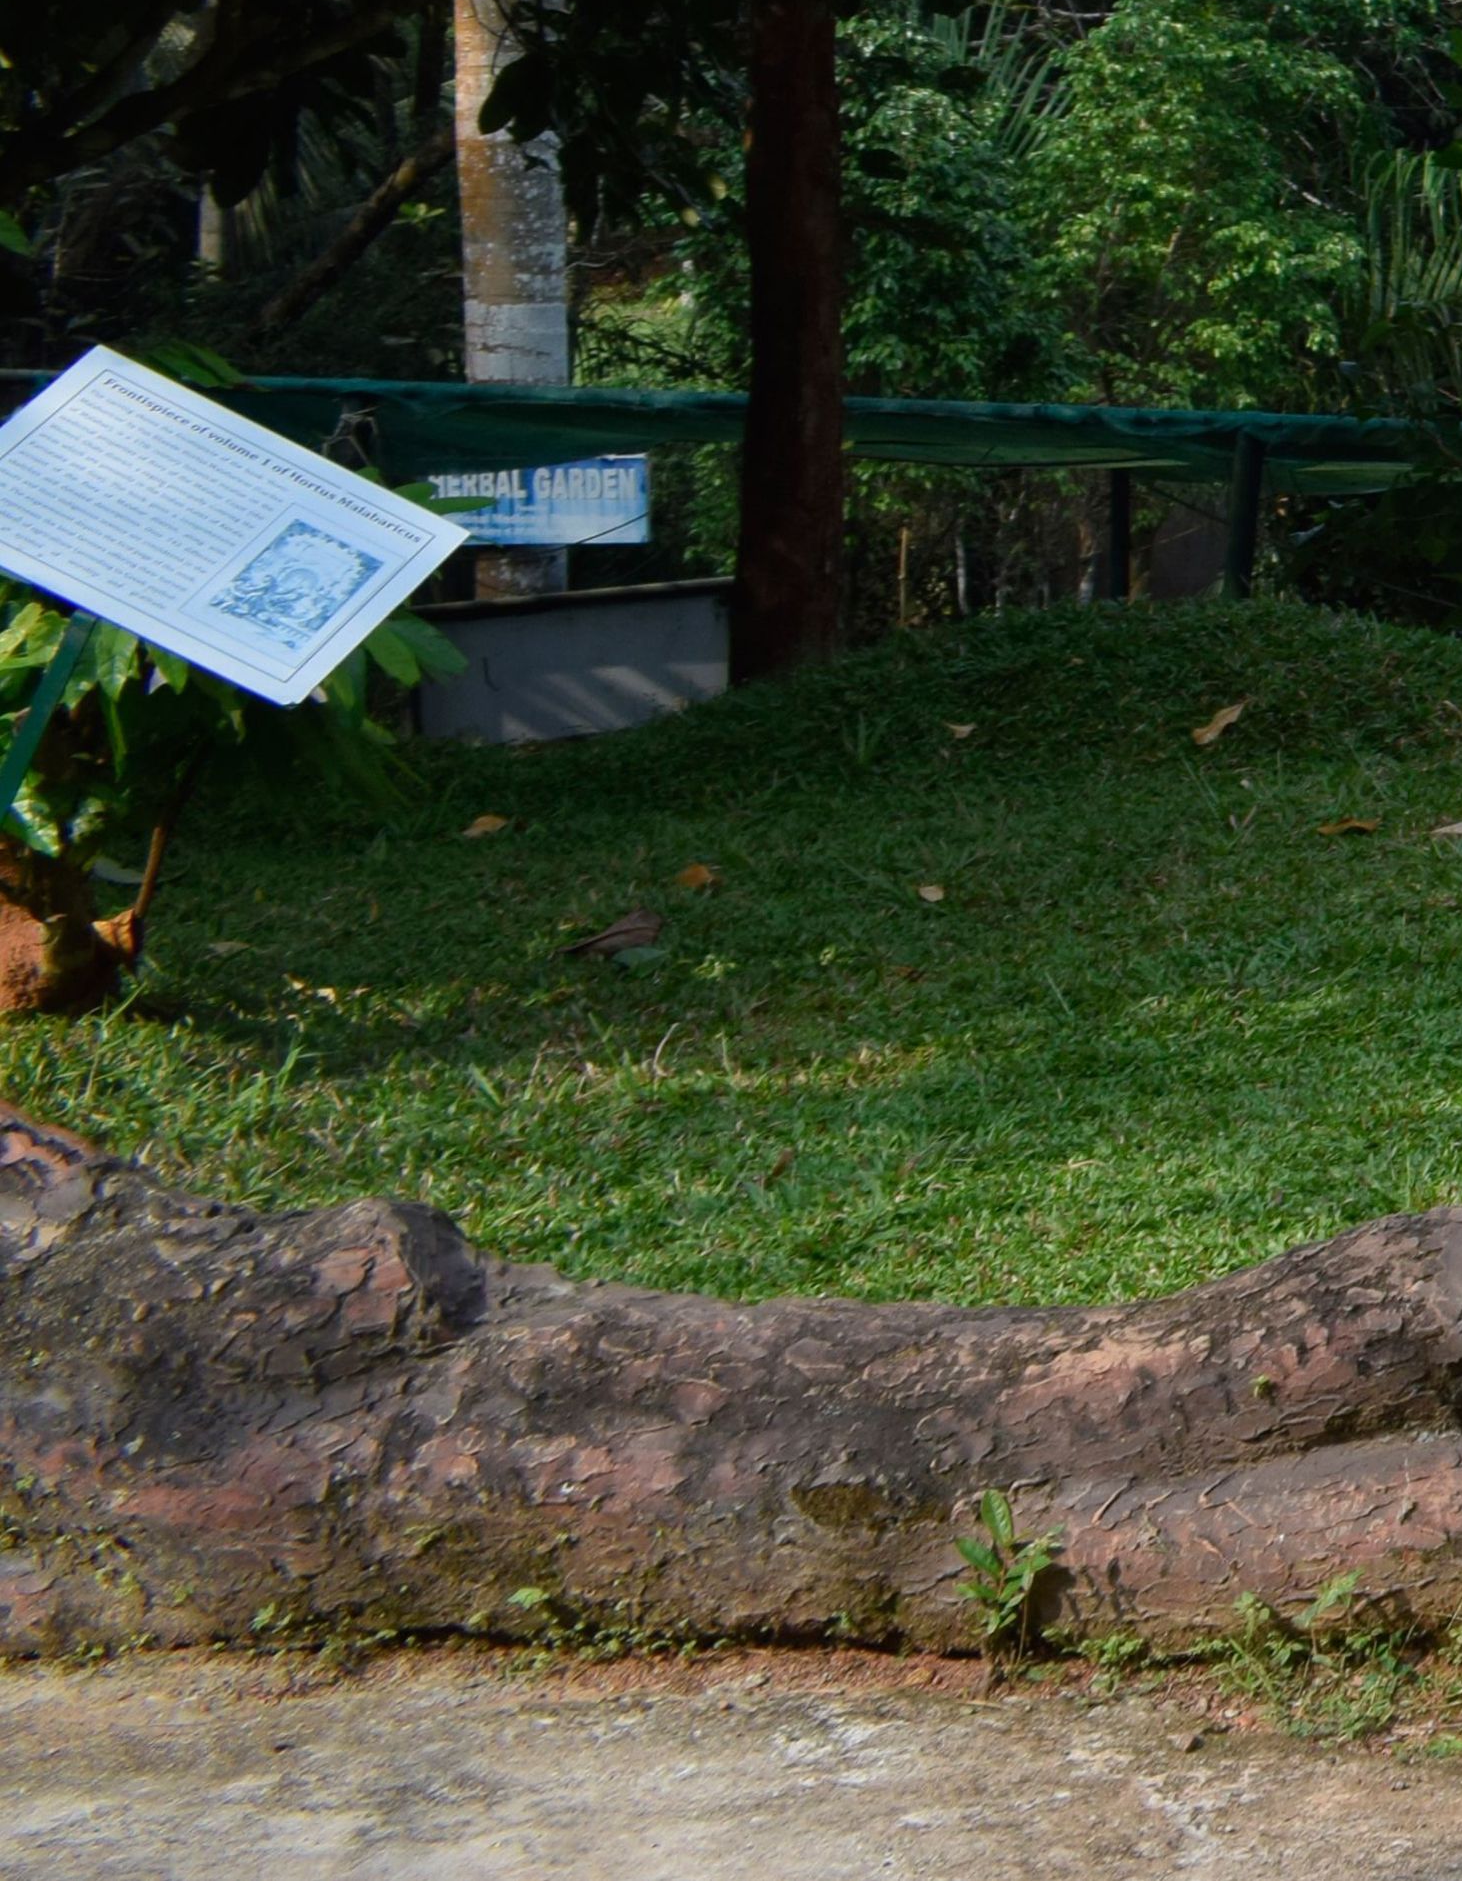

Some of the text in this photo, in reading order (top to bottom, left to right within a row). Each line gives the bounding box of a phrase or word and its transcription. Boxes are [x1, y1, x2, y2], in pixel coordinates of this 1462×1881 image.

[102, 376, 191, 425] Frontispiece
[189, 421, 212, 436] of
[207, 431, 262, 461] volume
[269, 461, 292, 477] of
[288, 471, 337, 501] Hortus
[337, 495, 424, 544] Malabaricus
[428, 467, 639, 500] HERBAL GARDEN
